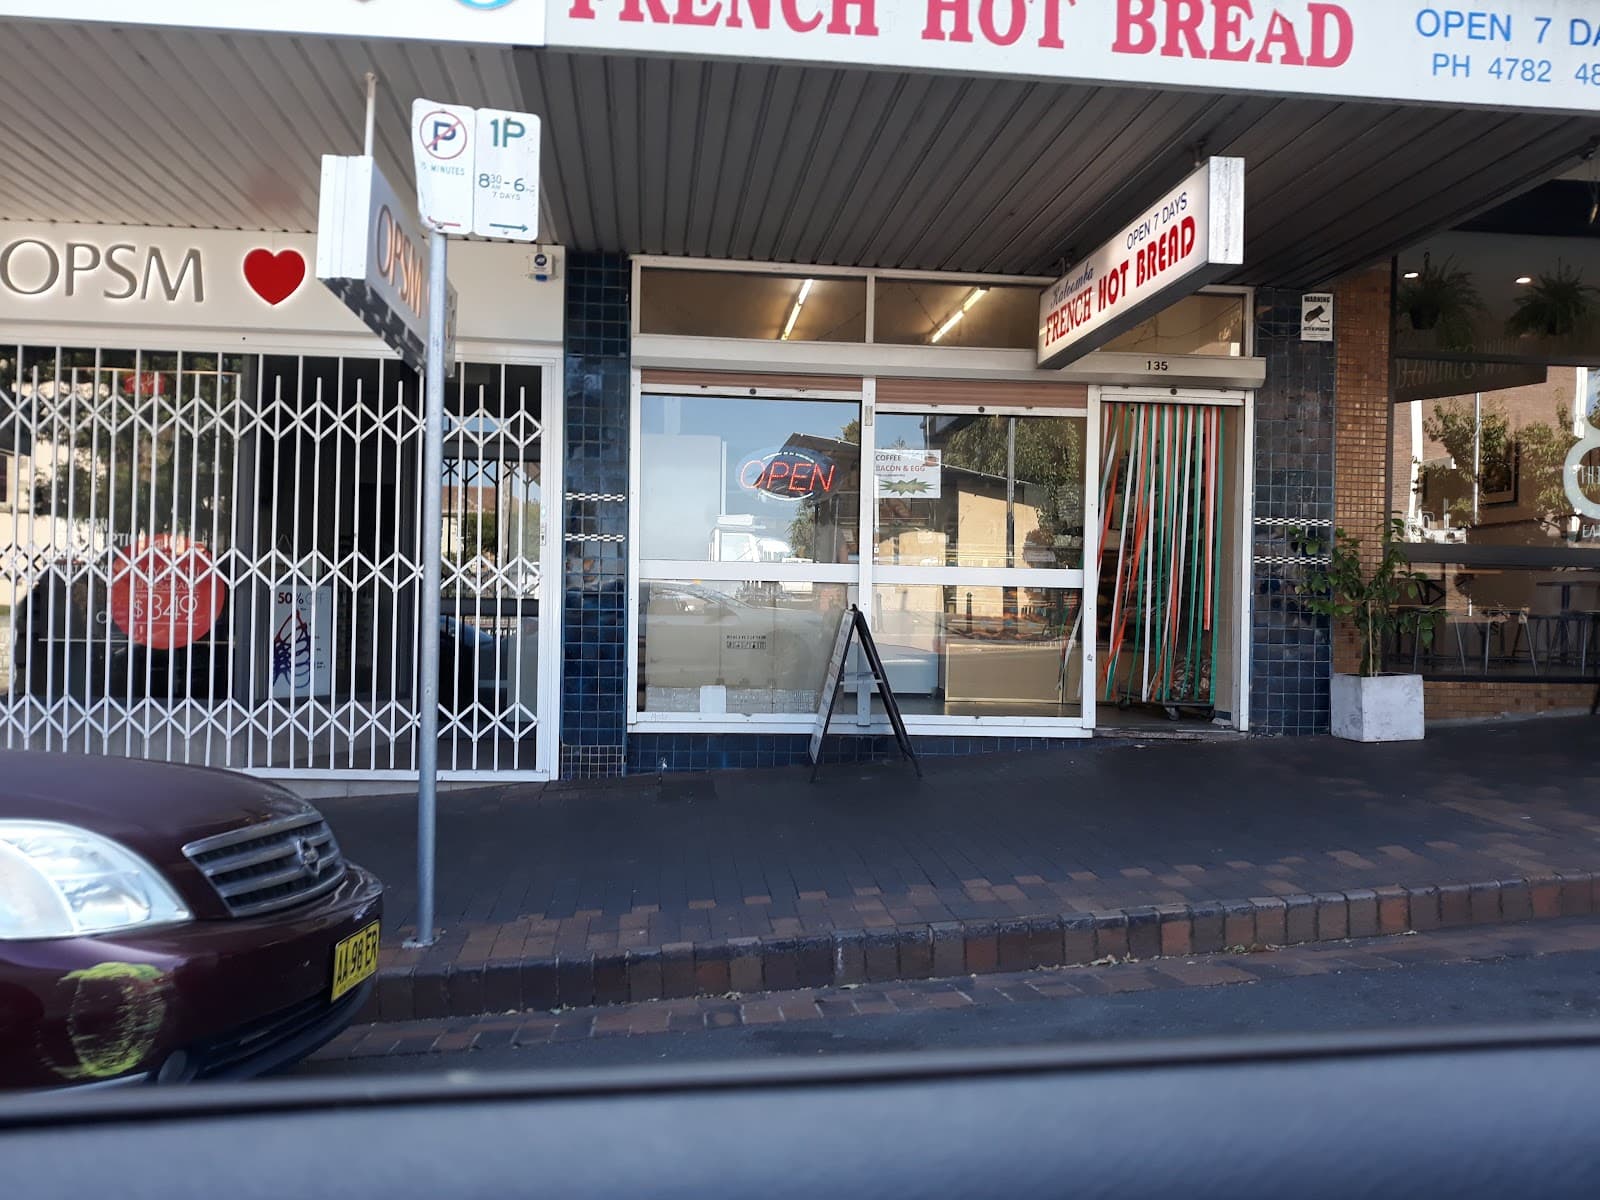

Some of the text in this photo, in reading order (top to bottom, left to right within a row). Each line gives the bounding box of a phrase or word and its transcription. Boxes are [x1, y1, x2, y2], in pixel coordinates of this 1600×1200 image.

[921, 0, 1067, 49] HOT
[1112, 0, 1354, 69] BREAD
[1416, 8, 1512, 42] OPEN
[1534, 16, 1553, 44] 7
[1432, 53, 1470, 78] PH
[1488, 57, 1552, 83] 4782
[489, 118, 526, 148] 1P
[431, 164, 465, 176] MINUTES
[499, 192, 521, 201] DAYS
[1126, 191, 1188, 250] OPEN 7 DAYS
[0, 238, 205, 304] OPSM
[377, 203, 424, 320] OPSM
[1044, 214, 1196, 347] FRENCH HOT BREAD
[1146, 361, 1169, 371] 135
[875, 454, 902, 462] COFFEE
[875, 464, 926, 472] BACON & EGG
[740, 459, 836, 493] OPEN
[277, 591, 304, 605] 50%
